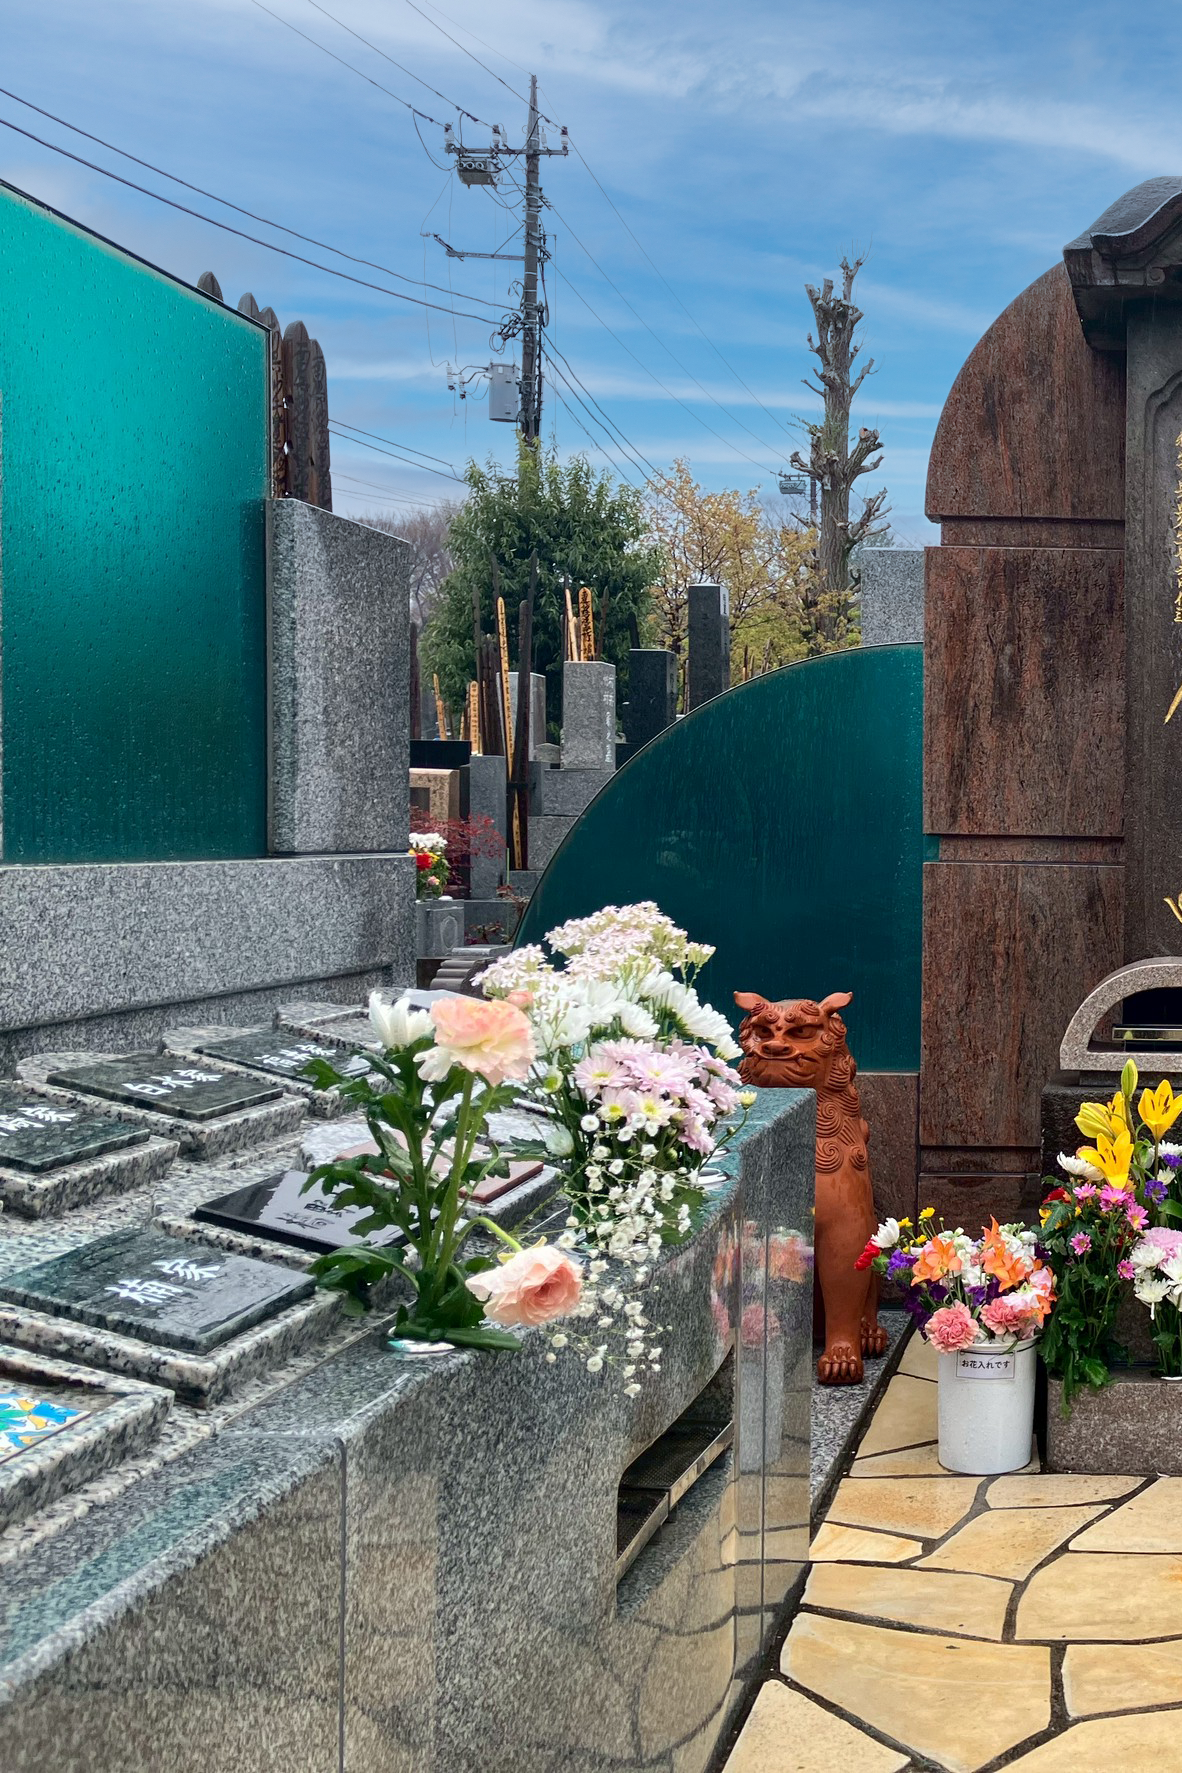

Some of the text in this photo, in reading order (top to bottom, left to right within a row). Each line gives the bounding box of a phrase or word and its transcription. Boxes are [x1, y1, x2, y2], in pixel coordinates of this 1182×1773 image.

[121, 1069, 224, 1096] 白水家
[104, 1259, 221, 1304] 楠家
[961, 1359, 1011, 1370] お花入れです
